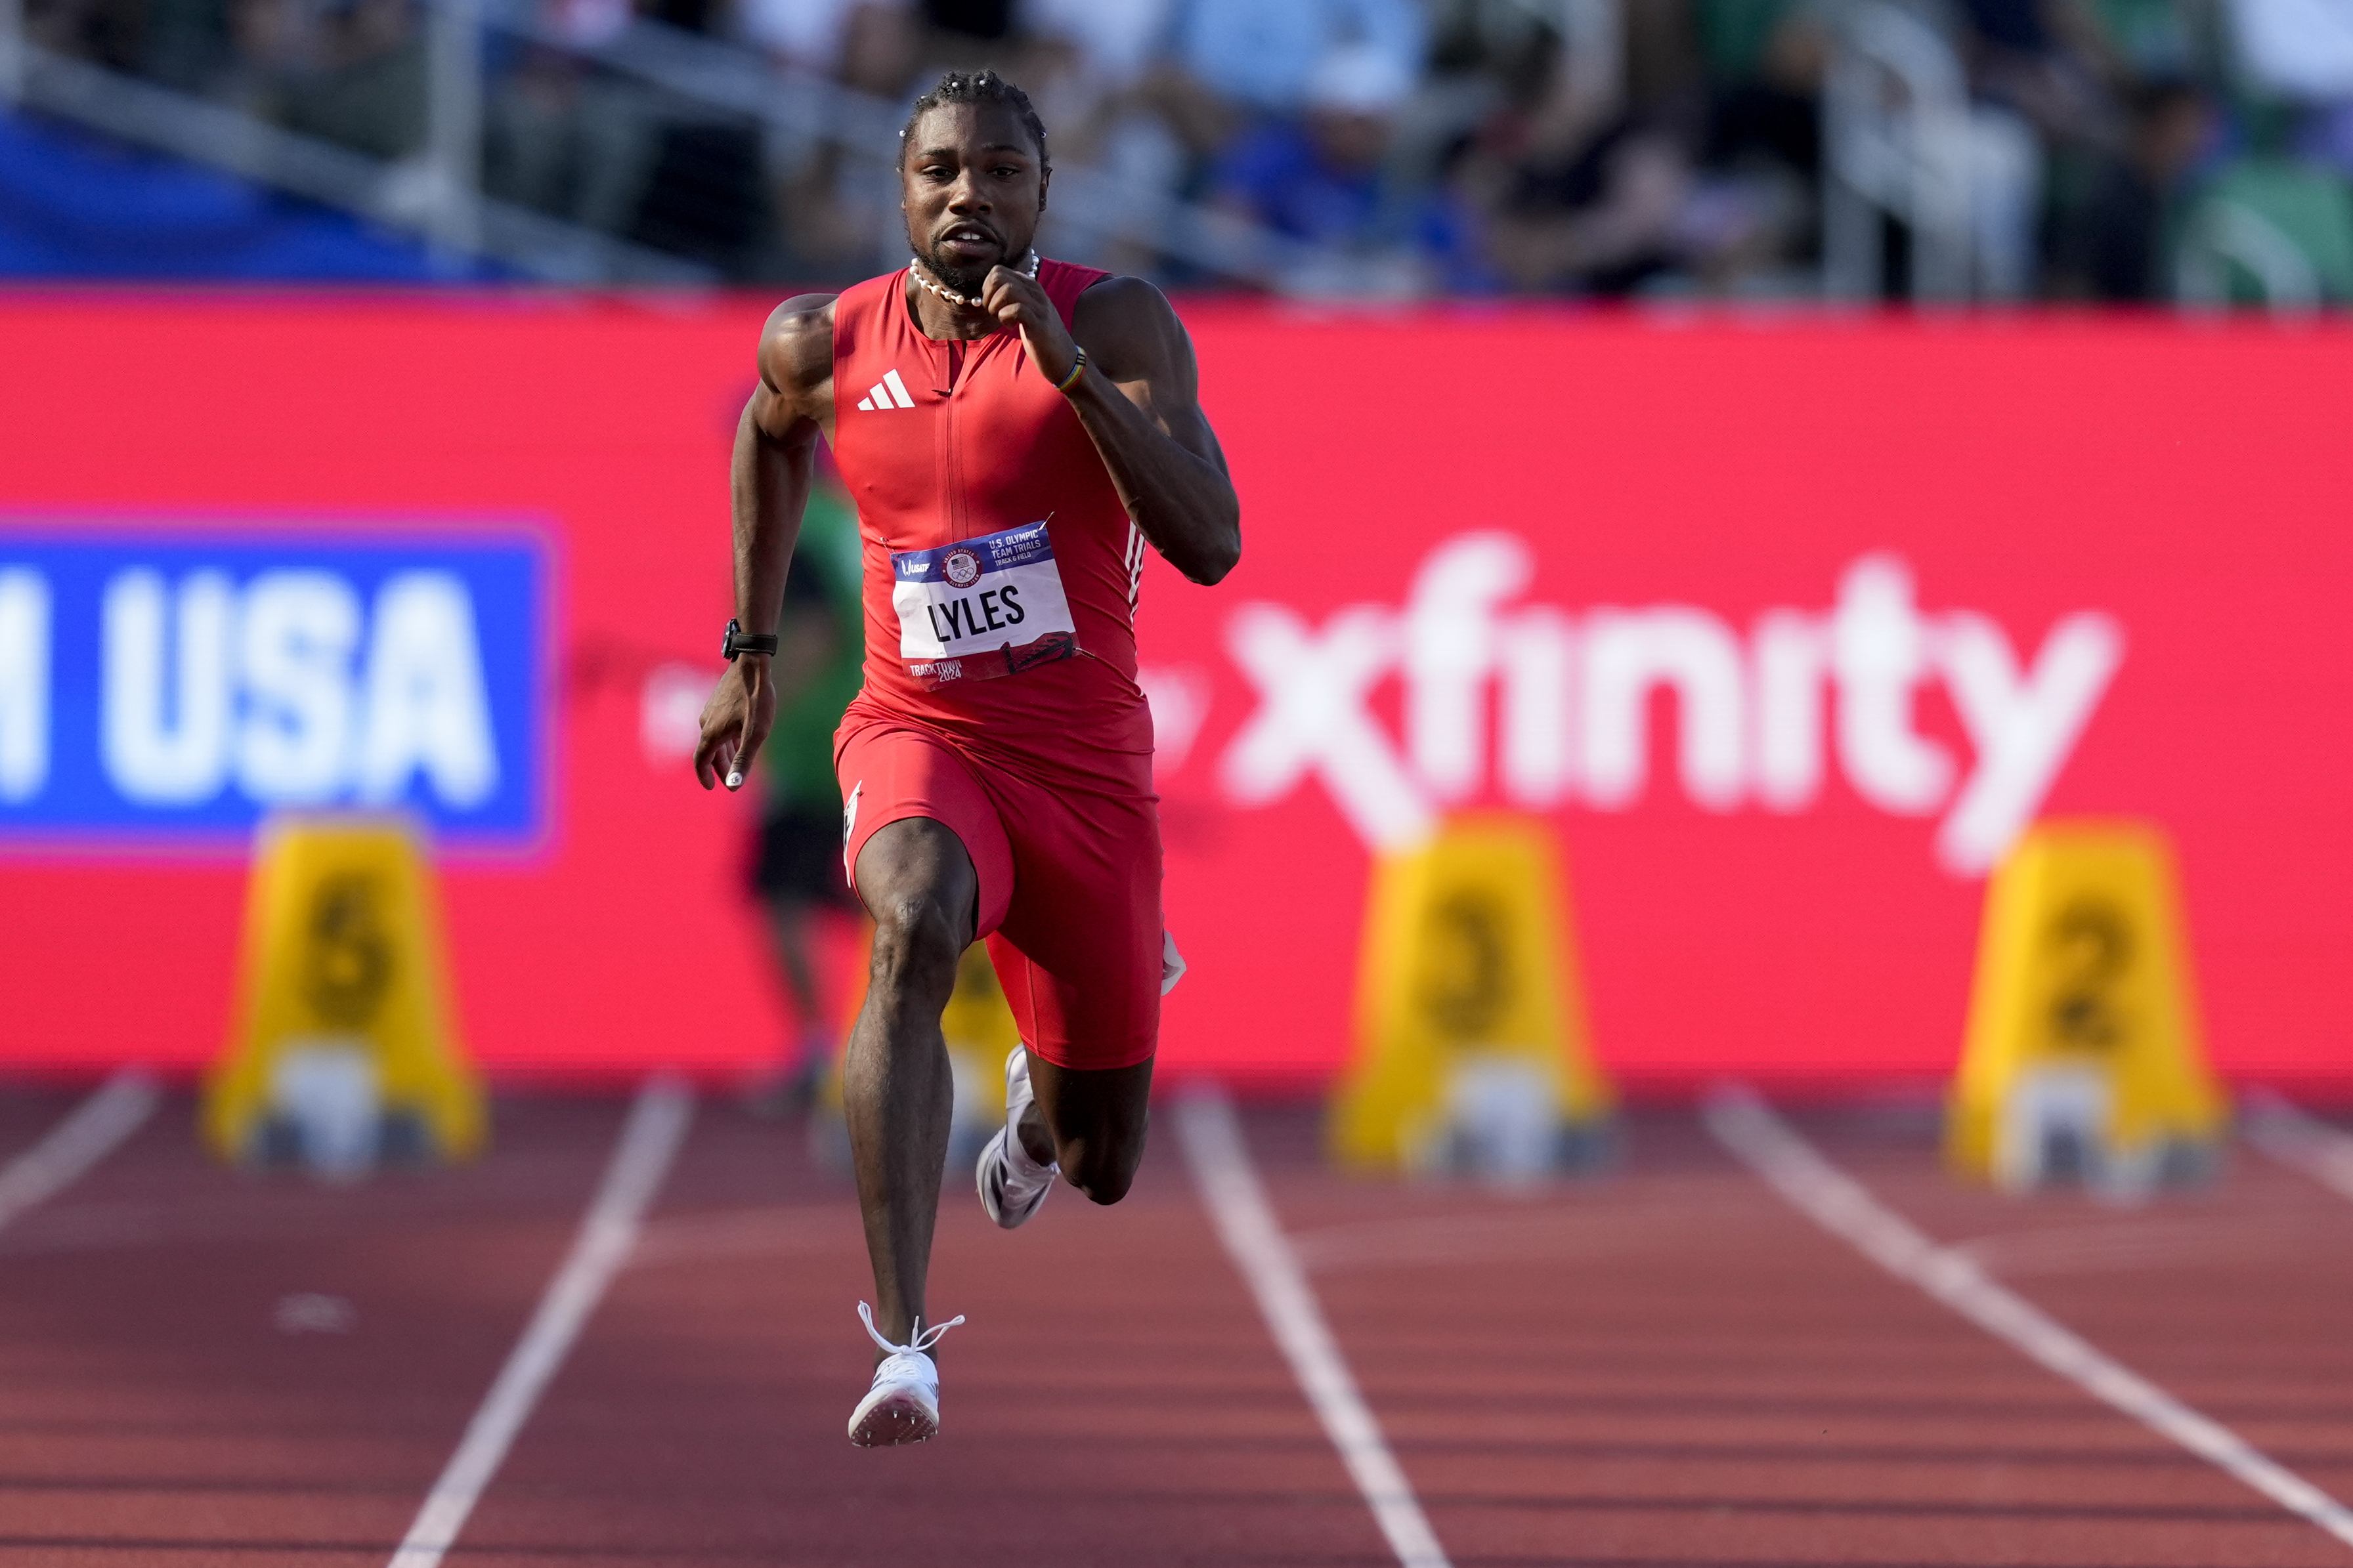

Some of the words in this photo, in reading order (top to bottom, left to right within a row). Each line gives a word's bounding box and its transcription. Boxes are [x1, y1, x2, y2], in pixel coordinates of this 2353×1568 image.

[989, 538, 1004, 549] U.S.
[1005, 530, 1039, 545] OLYMPIC
[991, 547, 1013, 559] TEAM
[1013, 540, 1041, 554] TRIALS
[995, 557, 1012, 566] TRACK
[1017, 551, 1031, 561] FIELD
[927, 585, 1025, 643] LYLES
[100, 566, 499, 811] USA
[939, 667, 962, 683] 2024
[1219, 532, 2123, 874] xfinity
[2039, 894, 2135, 1051] 2
